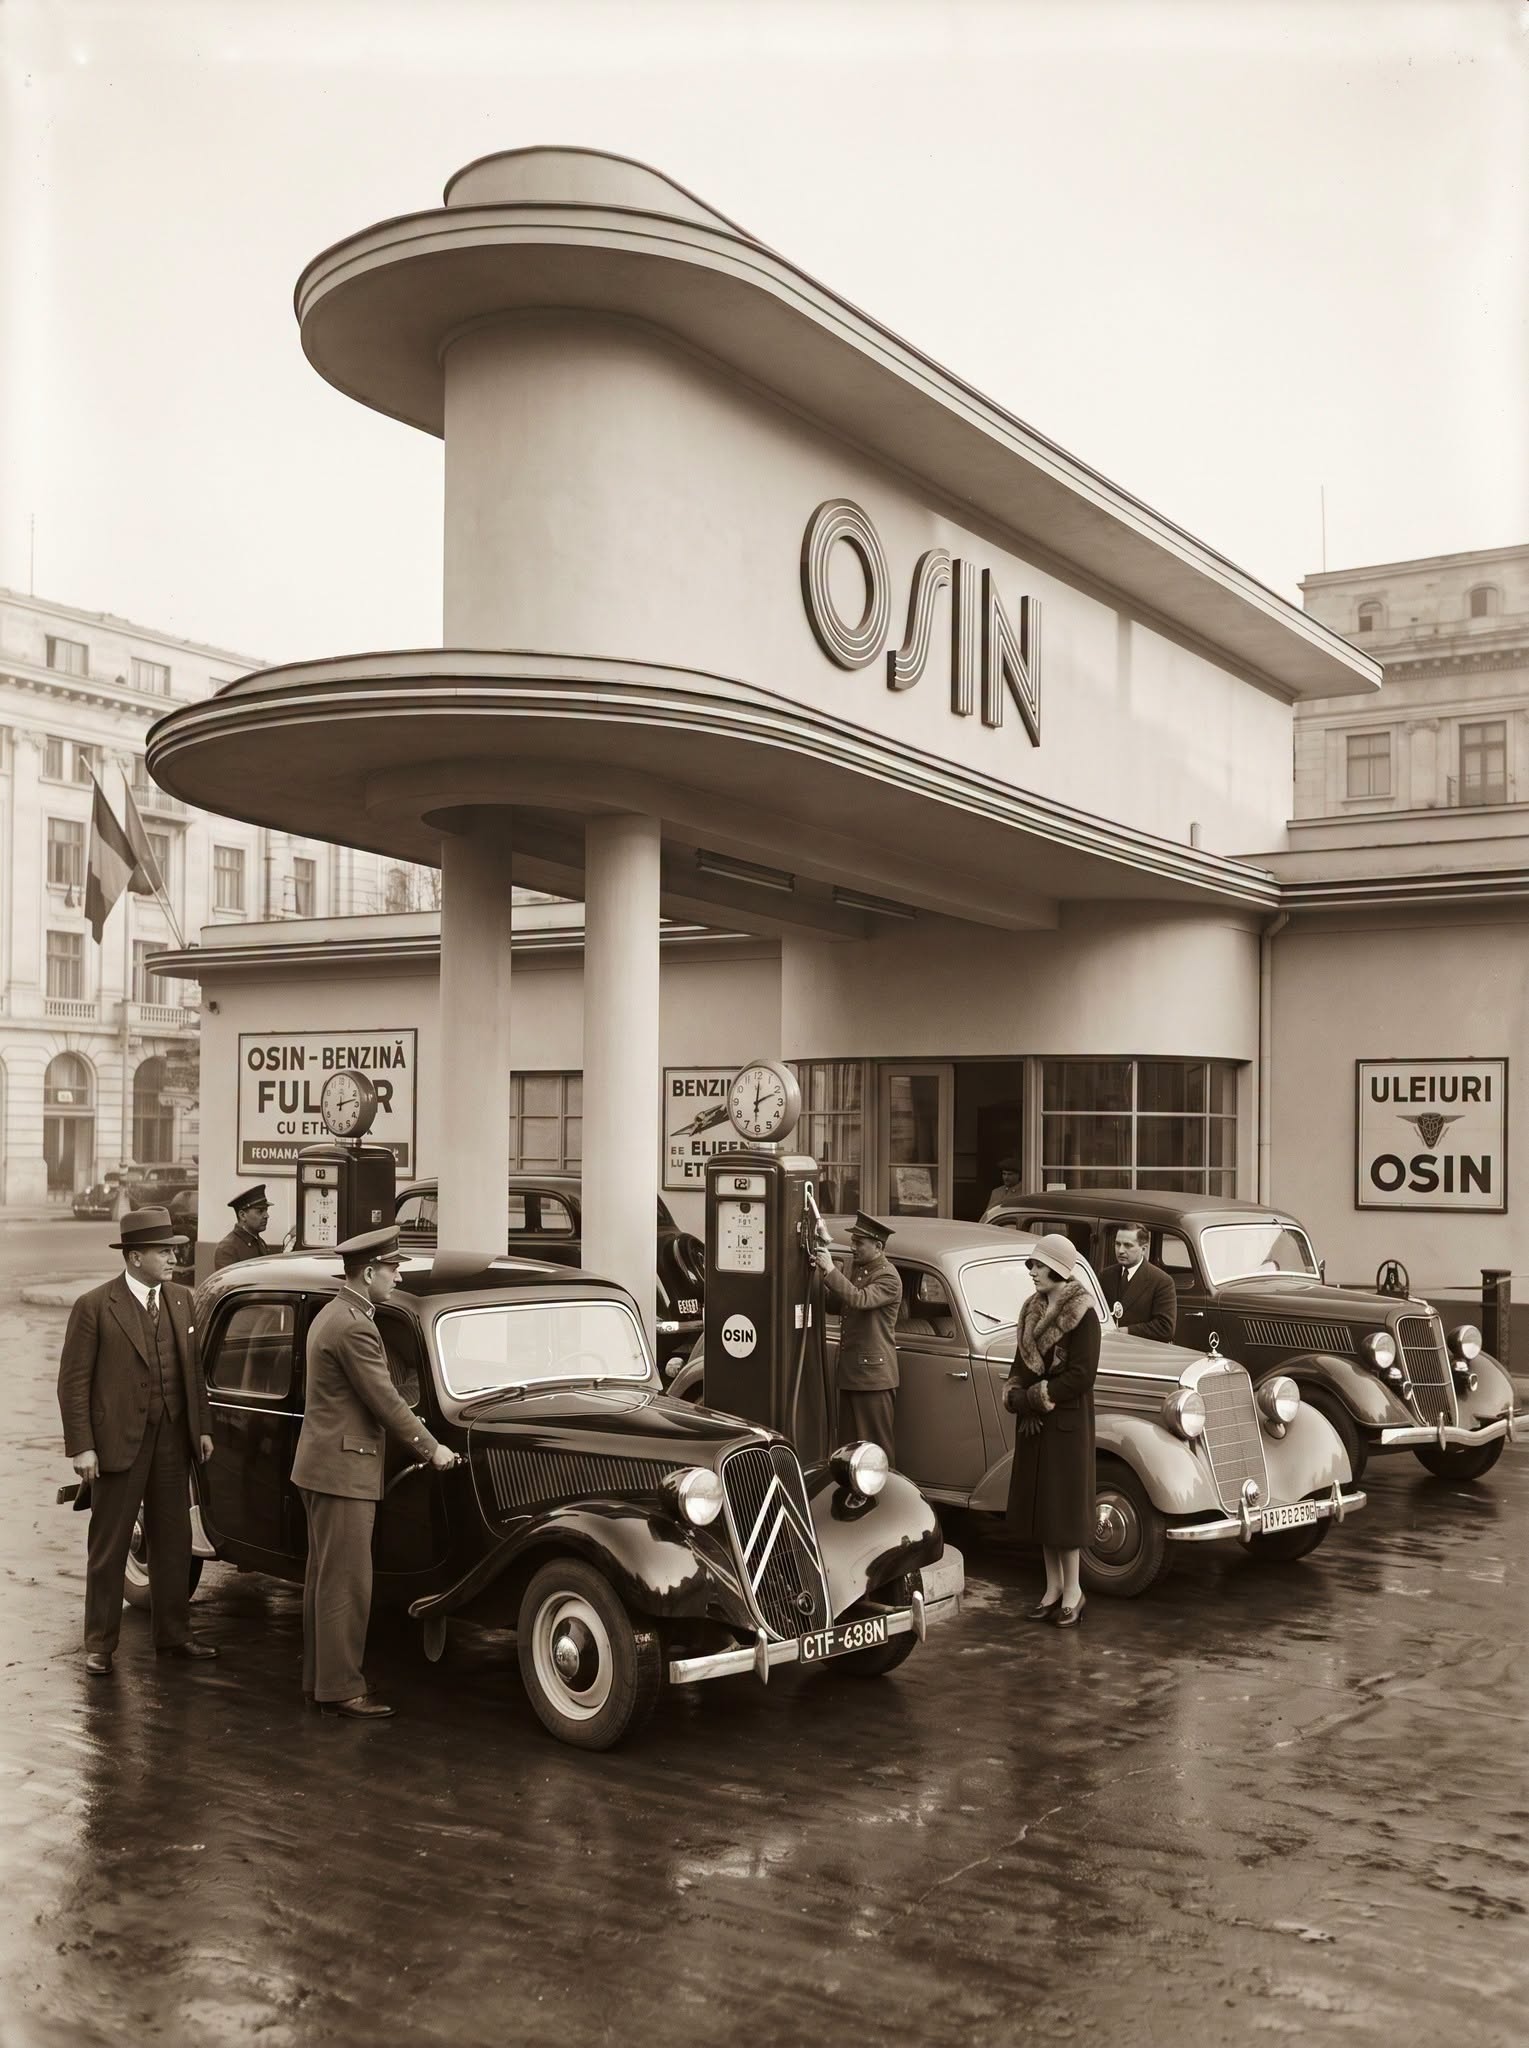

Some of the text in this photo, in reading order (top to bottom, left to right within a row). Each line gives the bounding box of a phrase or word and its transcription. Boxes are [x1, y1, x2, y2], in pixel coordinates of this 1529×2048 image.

[800, 498, 1042, 747] OSIN
[1371, 1075, 1492, 1103] ULEIURI
[276, 1121, 296, 1135] CU
[1370, 1154, 1492, 1194] OSIN
[723, 1329, 754, 1343] OSIN
